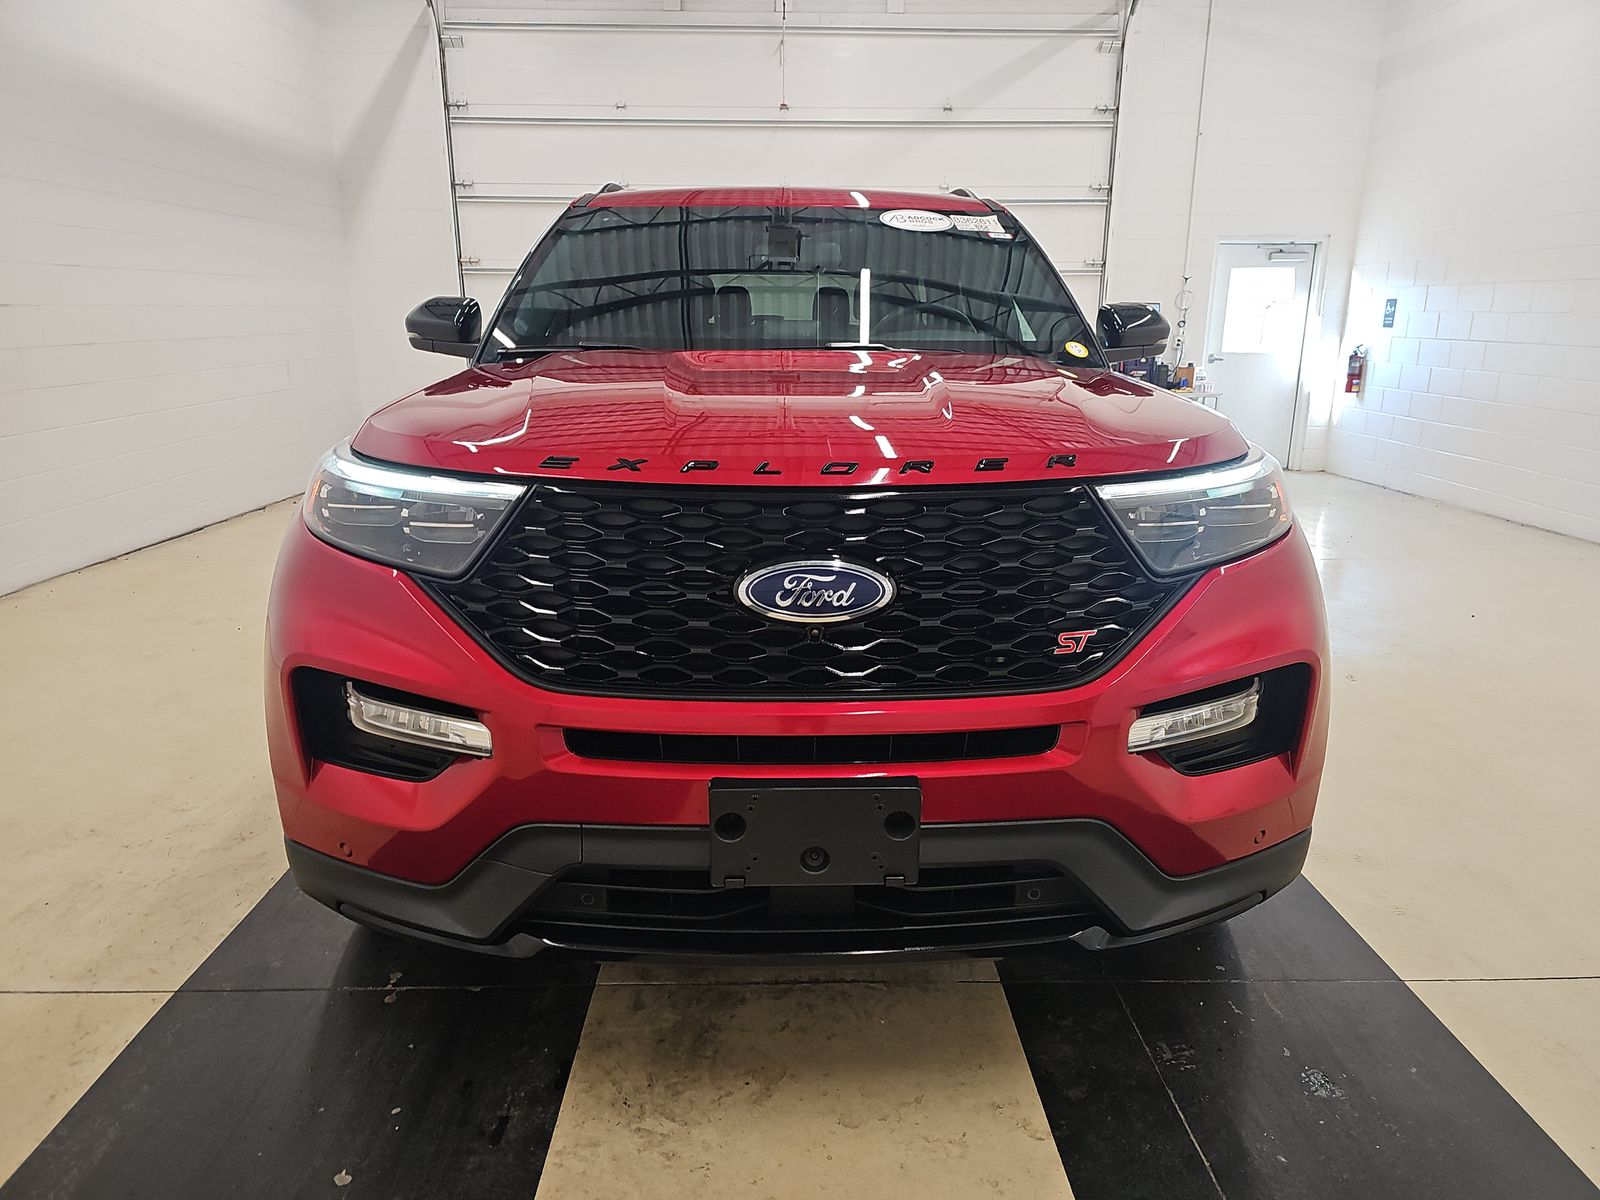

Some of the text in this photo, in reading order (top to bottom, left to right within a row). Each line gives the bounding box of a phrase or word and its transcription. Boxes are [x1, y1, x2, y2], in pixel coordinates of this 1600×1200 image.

[538, 454, 1077, 476] EXPLORER
[775, 573, 857, 608] Ford
[1053, 629, 1098, 655] ST
